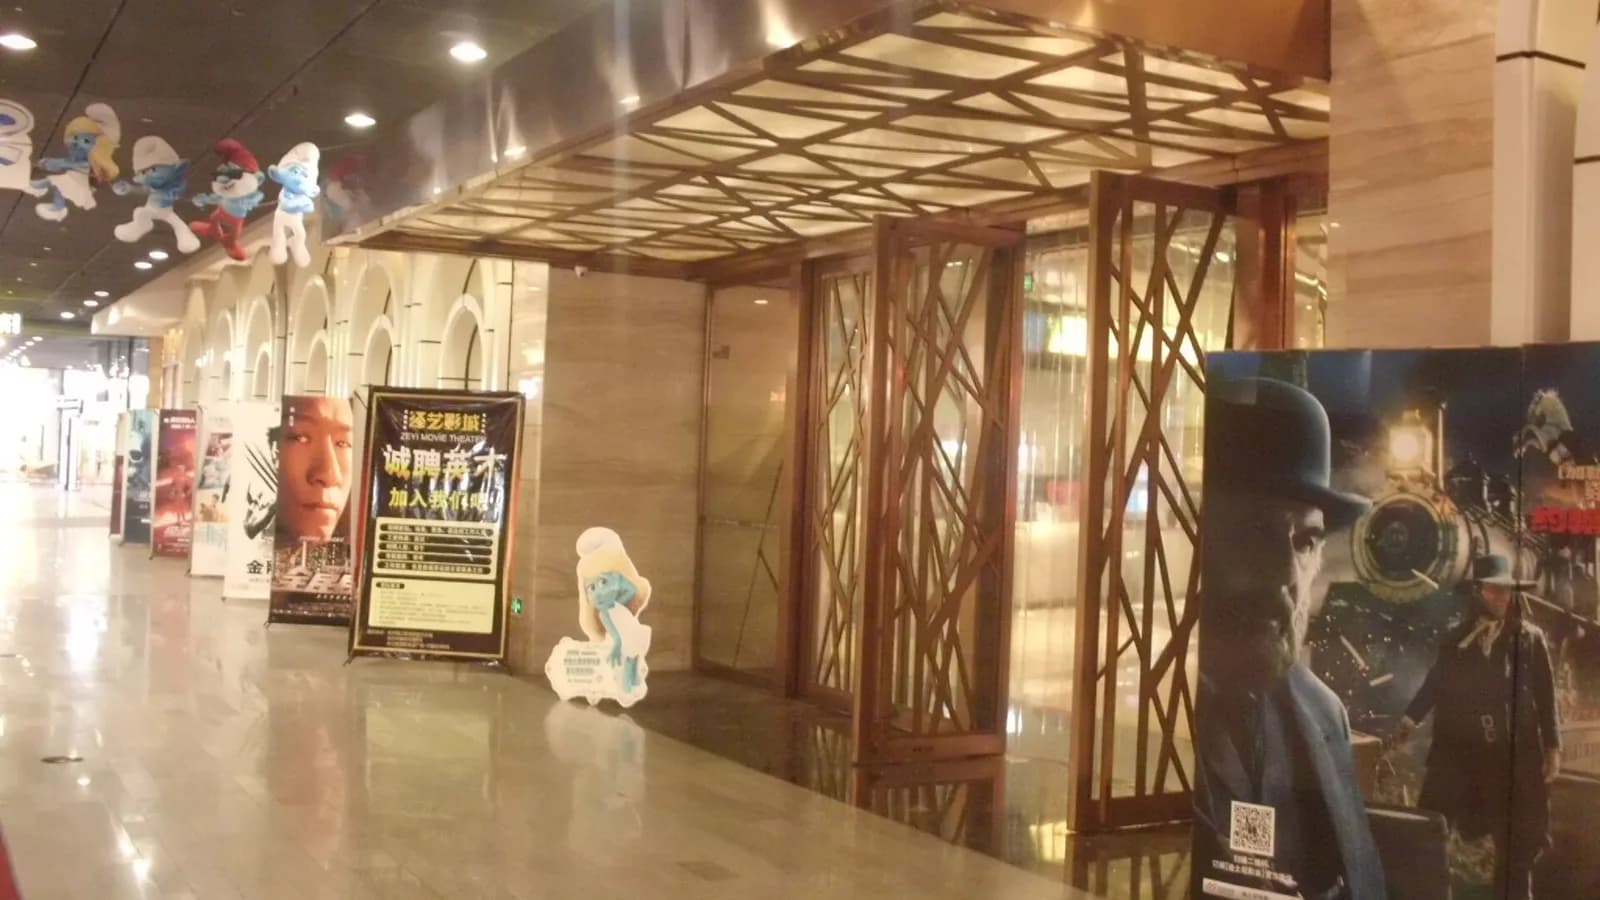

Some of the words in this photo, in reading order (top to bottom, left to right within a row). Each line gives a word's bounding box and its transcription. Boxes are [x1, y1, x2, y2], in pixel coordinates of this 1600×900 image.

[400, 432, 419, 441] ZEYI
[421, 433, 448, 442] MOVIE
[382, 444, 508, 481] 诚聘英才
